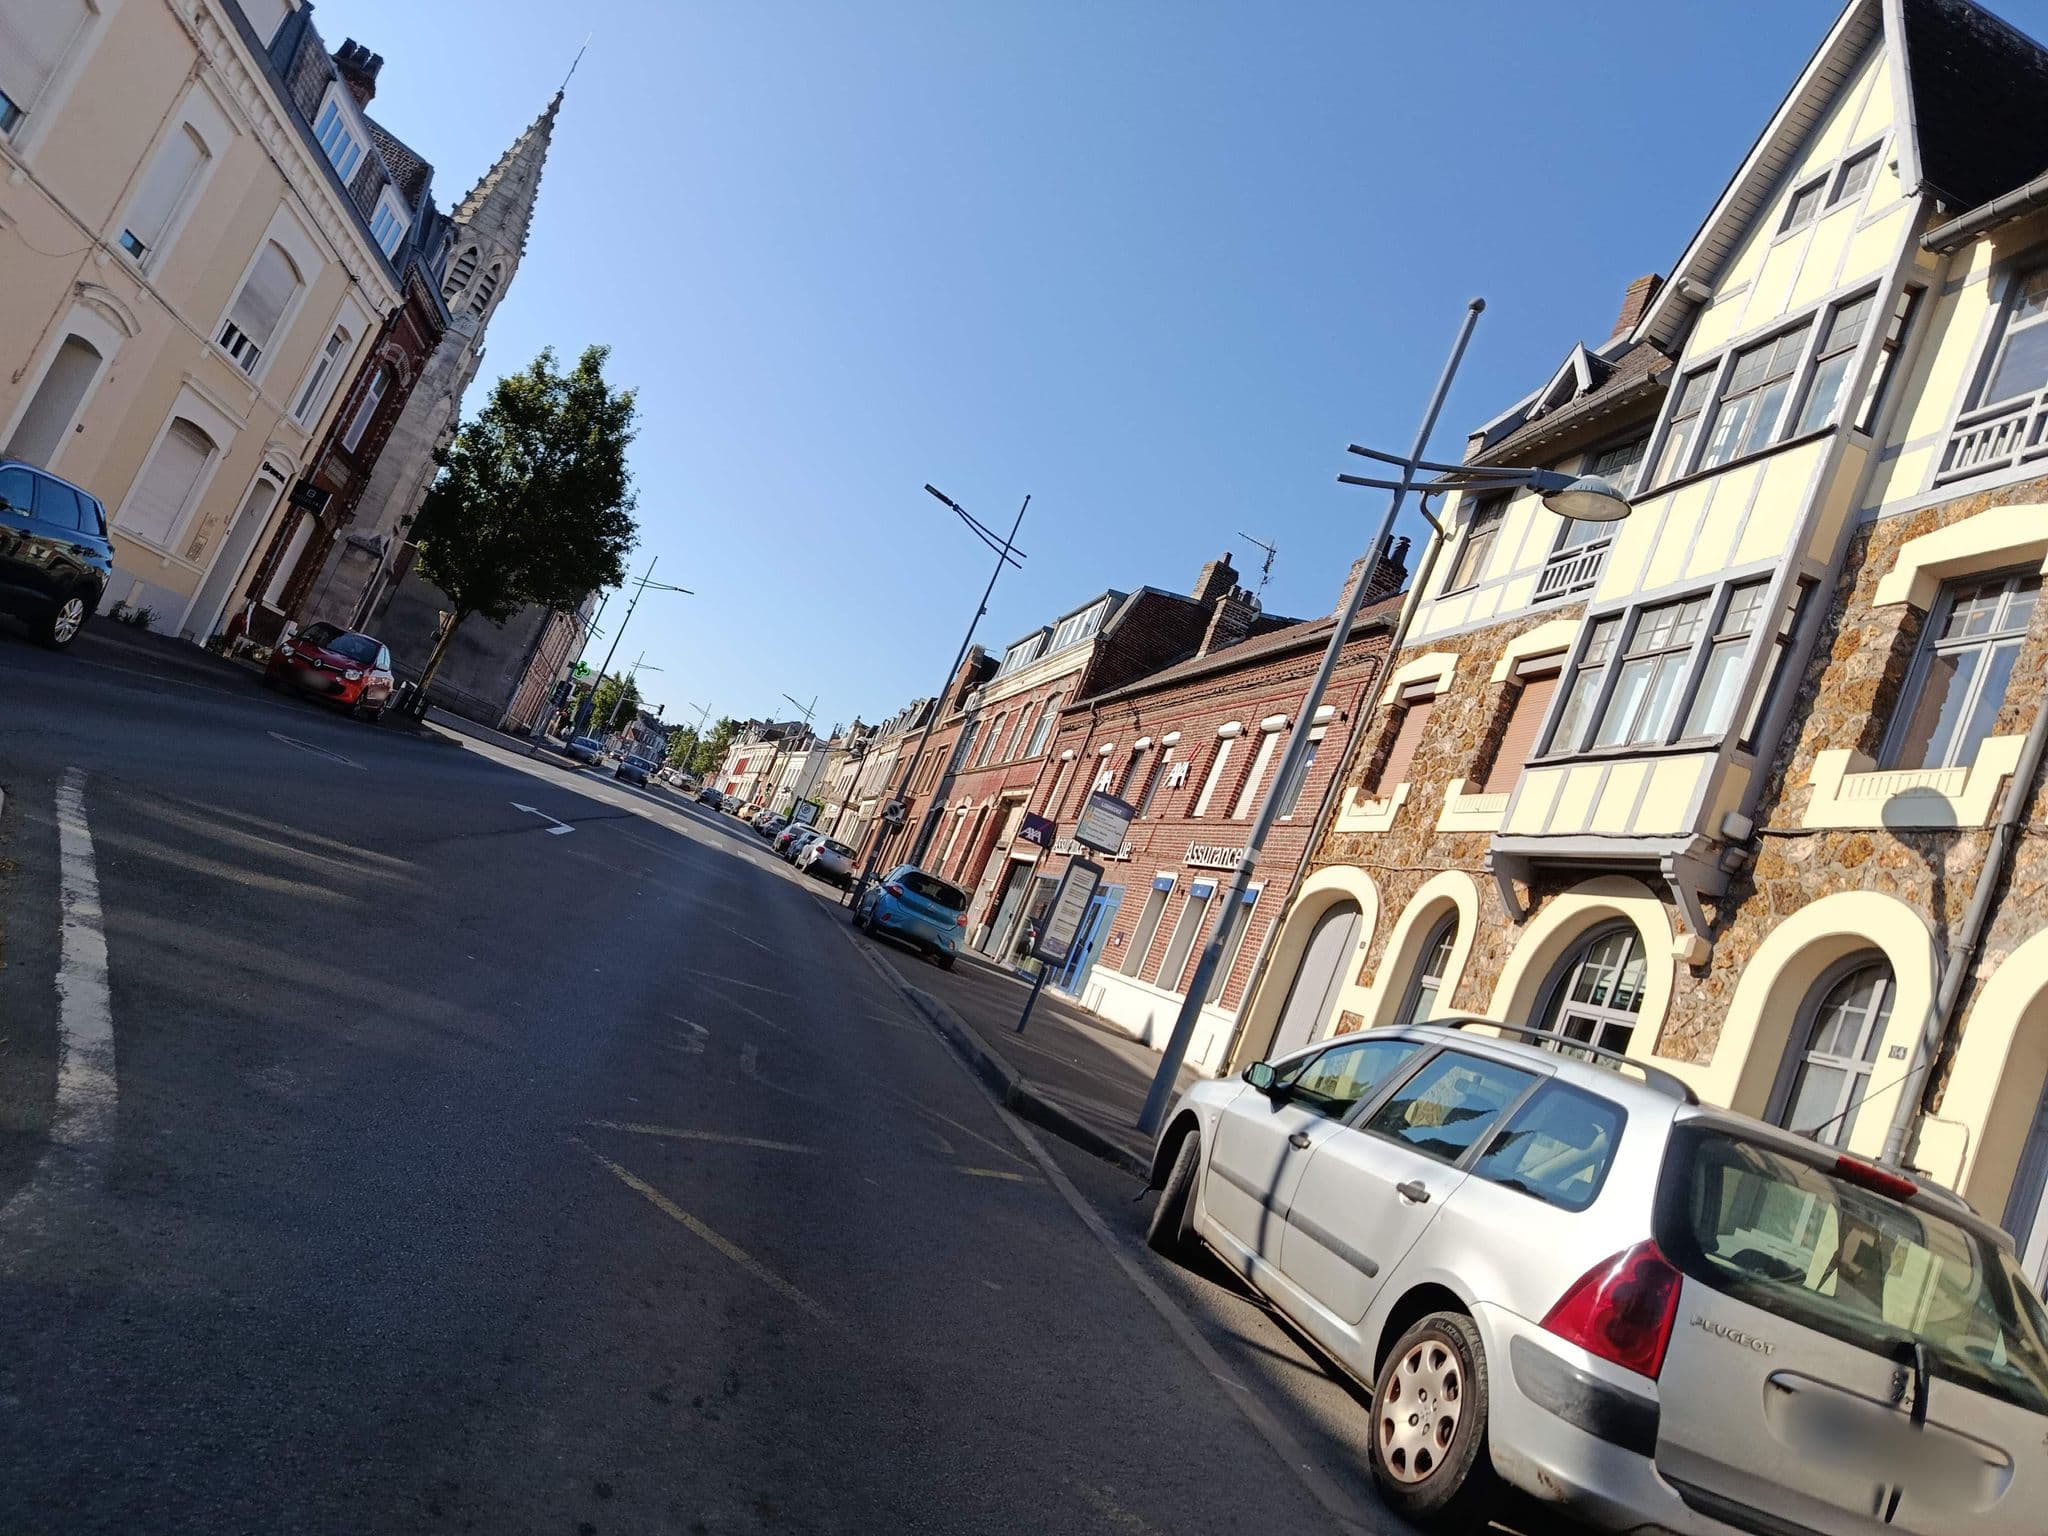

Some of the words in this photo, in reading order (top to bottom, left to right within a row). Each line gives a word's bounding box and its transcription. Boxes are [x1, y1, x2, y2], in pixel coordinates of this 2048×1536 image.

[1019, 826, 1042, 844] AXA
[1182, 840, 1243, 867] Assurance
[1690, 1314, 1775, 1355] PEUGEOT
